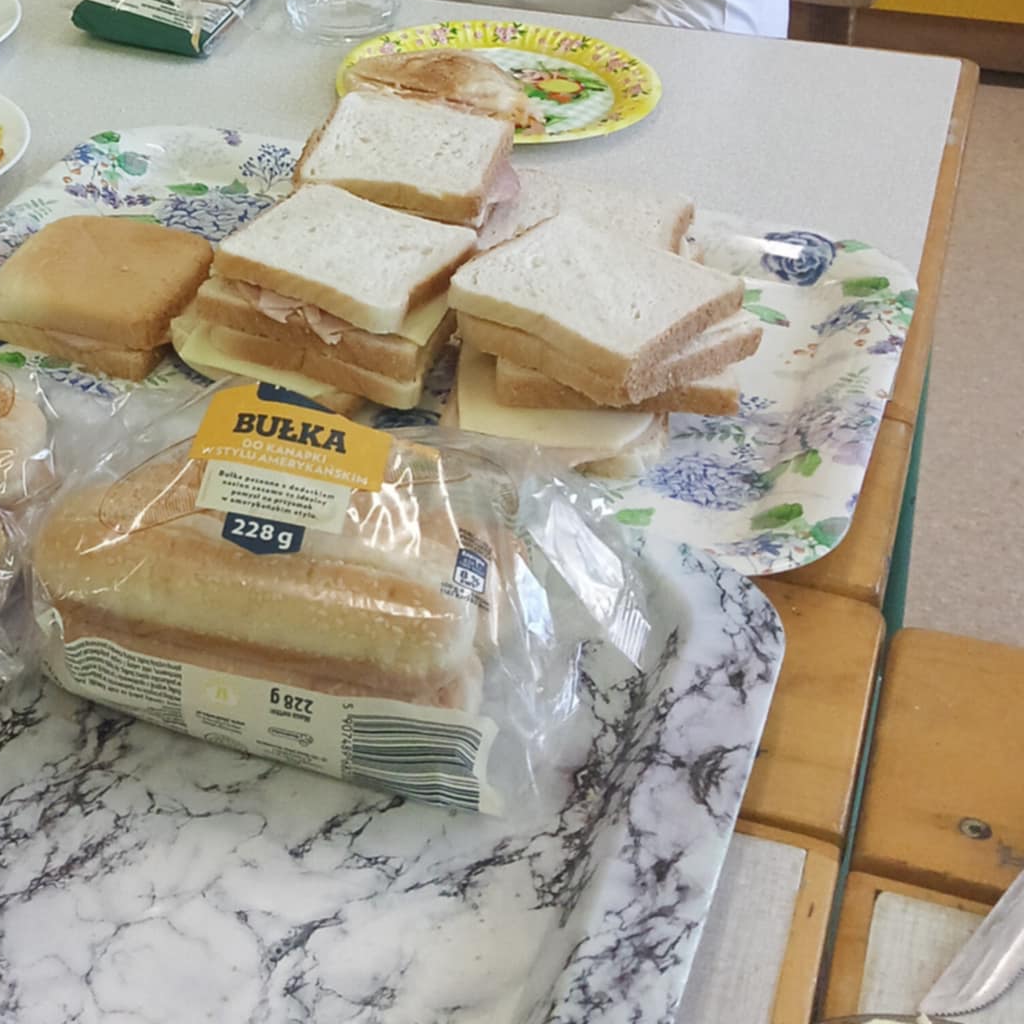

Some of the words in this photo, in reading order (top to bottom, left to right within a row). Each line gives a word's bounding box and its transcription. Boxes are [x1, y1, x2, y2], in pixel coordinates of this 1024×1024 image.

[232, 413, 347, 454] BUŁKA
[242, 438, 264, 450] DO
[266, 443, 327, 464] KANAPKI
[216, 446, 257, 461] STYLU
[258, 453, 369, 486] AMERYKAŃSKIM
[231, 518, 274, 542] 228
[277, 531, 293, 550] g
[270, 687, 280, 704] g
[284, 694, 314, 714] 228
